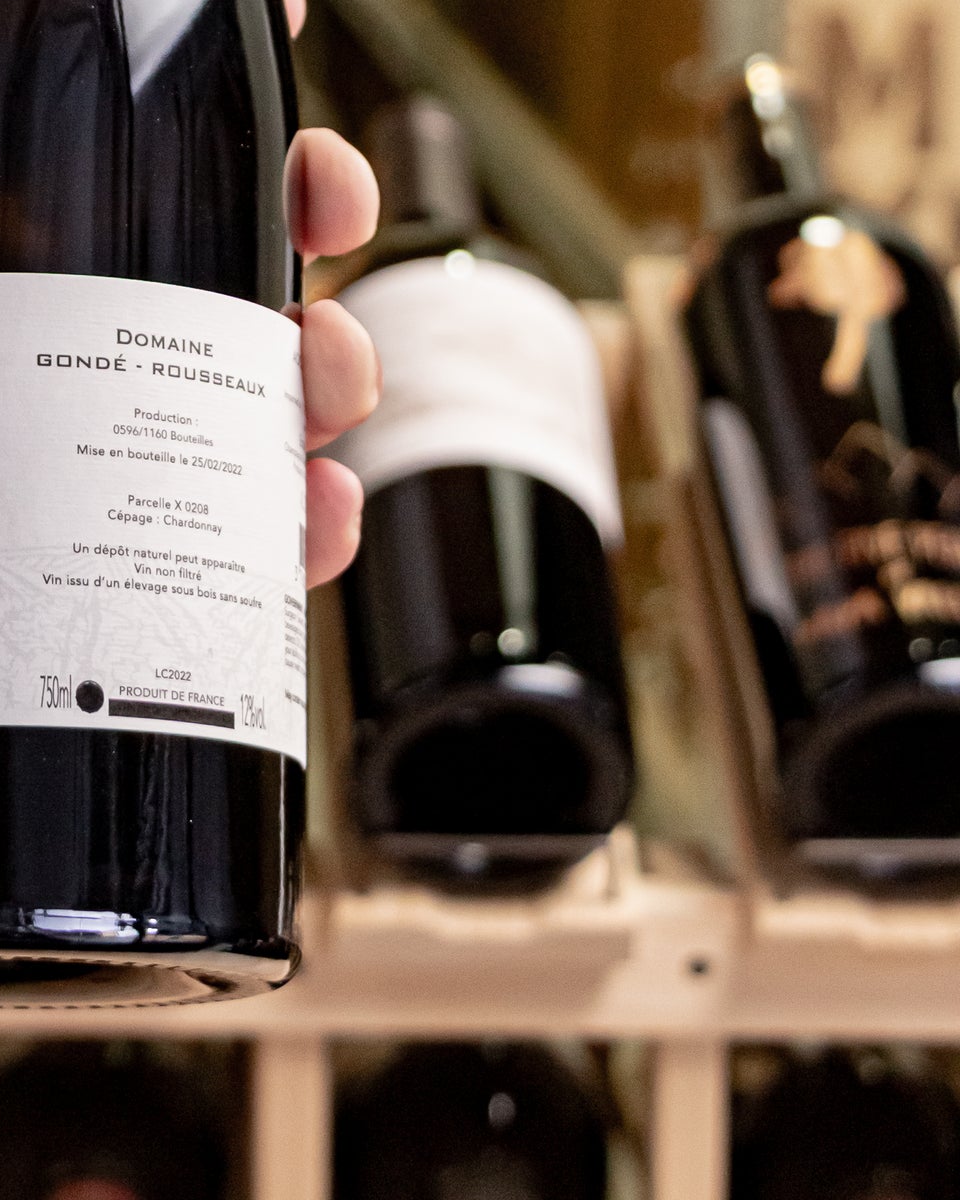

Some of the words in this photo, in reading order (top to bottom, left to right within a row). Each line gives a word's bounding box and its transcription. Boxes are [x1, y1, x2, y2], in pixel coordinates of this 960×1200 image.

[36, 353, 127, 372] GONDÉ
[152, 363, 266, 398] ROUSSEAUX
[134, 408, 192, 426] Production
[113, 424, 168, 441] 0596/1160
[170, 430, 214, 448] Bouteilles
[76, 444, 105, 458] Mise
[109, 449, 123, 458] en
[127, 447, 176, 465] bouteille
[179, 453, 188, 466] le
[191, 456, 243, 476] 25/02/2022
[127, 495, 171, 509] Parcelle
[174, 500, 183, 511] X
[184, 501, 209, 515] 0208
[107, 509, 153, 527] Cépage
[163, 514, 222, 536] Chardonnay
[72, 542, 90, 555] Un
[93, 543, 130, 561] dépôt
[133, 547, 172, 561] naturel
[175, 553, 198, 567] peut
[134, 562, 152, 576] Vin
[155, 568, 176, 578] non
[179, 566, 202, 582] filtré
[42, 573, 62, 586] Vin
[66, 575, 89, 587] issu
[93, 575, 120, 590] d'un
[124, 577, 168, 596] élevage
[171, 584, 194, 597] sous
[197, 585, 217, 600] bois
[219, 591, 238, 603] sans
[239, 593, 262, 609] soufre
[155, 668, 192, 682] LC2022
[40, 674, 72, 709] 750ml
[119, 685, 168, 701] PRODUIT
[170, 690, 186, 702] DE
[188, 691, 225, 707] FRANCE
